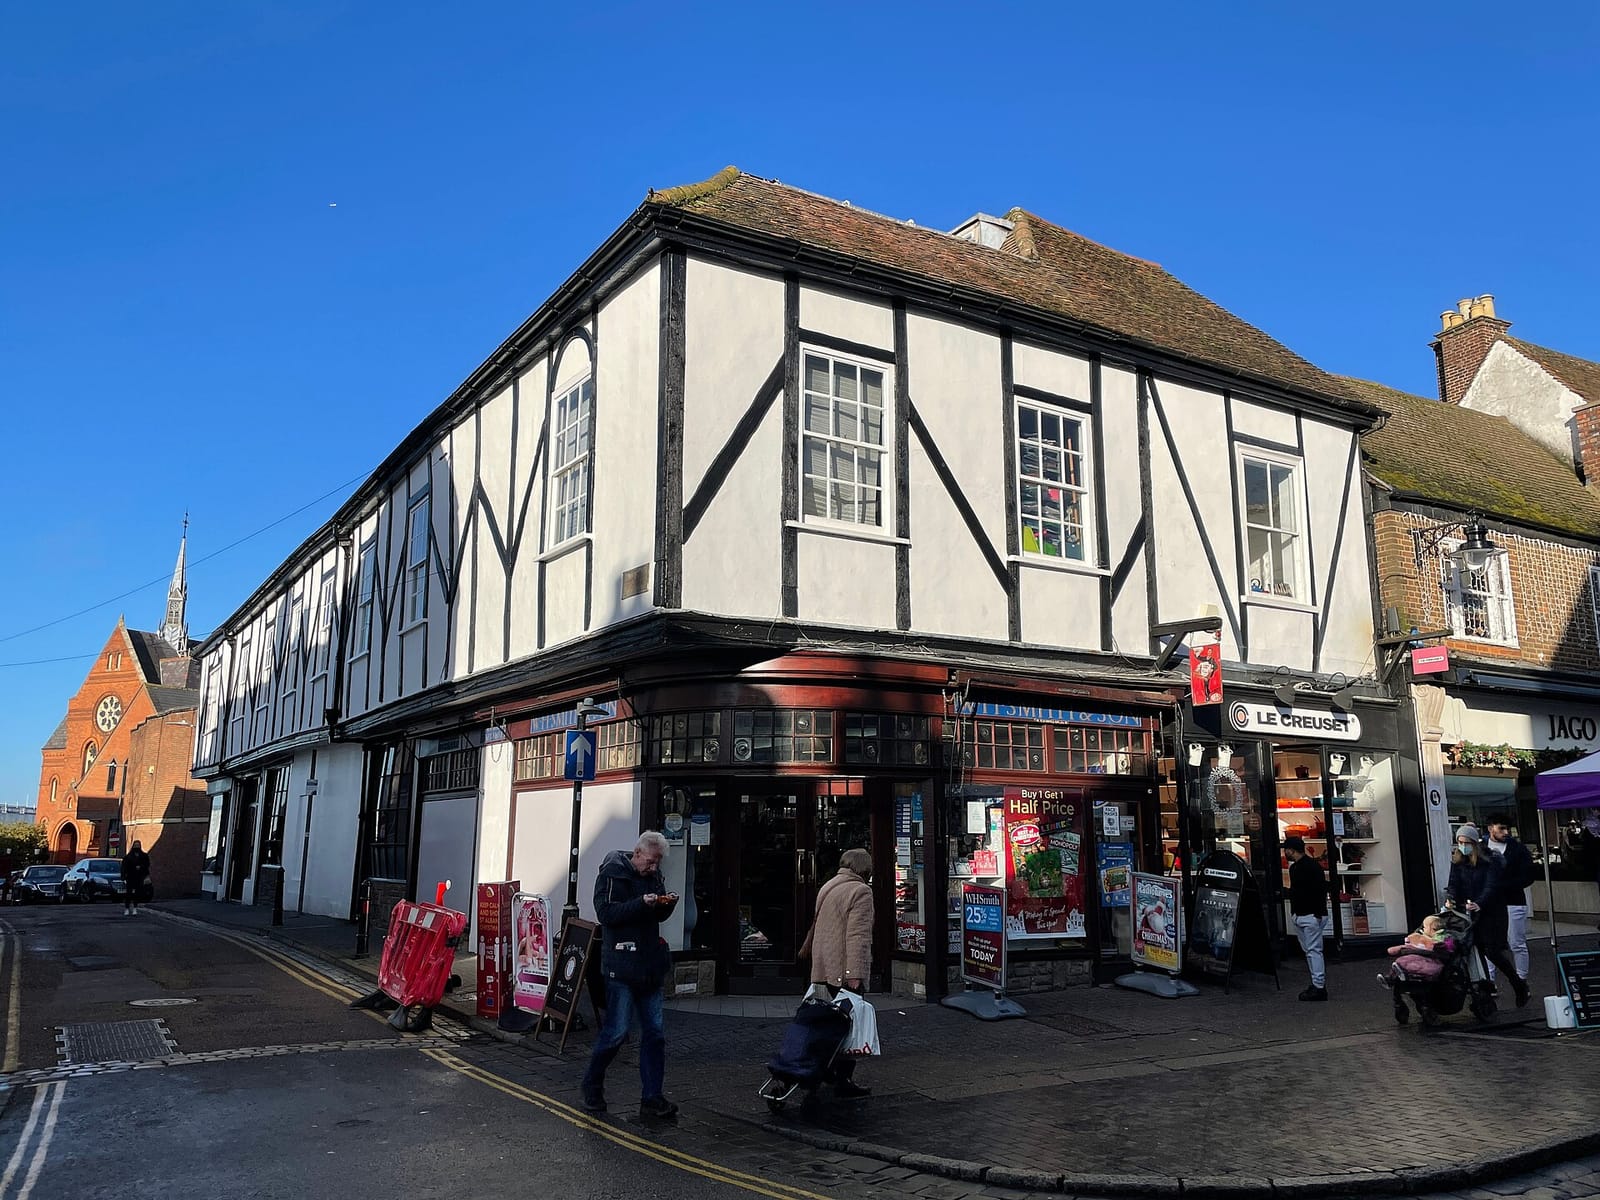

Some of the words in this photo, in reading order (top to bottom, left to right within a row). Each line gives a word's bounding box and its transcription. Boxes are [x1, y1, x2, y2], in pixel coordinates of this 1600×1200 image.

[1256, 711, 1278, 726] LE
[1280, 713, 1350, 732] CREUSET
[1548, 714, 1597, 741] JAGO
[1021, 789, 1037, 800] Buy
[1038, 790, 1043, 799] 1
[1044, 790, 1059, 800] Get
[1060, 791, 1064, 799] 1
[1010, 799, 1039, 814] Half
[1042, 800, 1075, 815] Price
[1050, 839, 1078, 850] MONOPOLY
[965, 893, 1000, 906] WHSmith
[970, 948, 994, 963] TODAY
